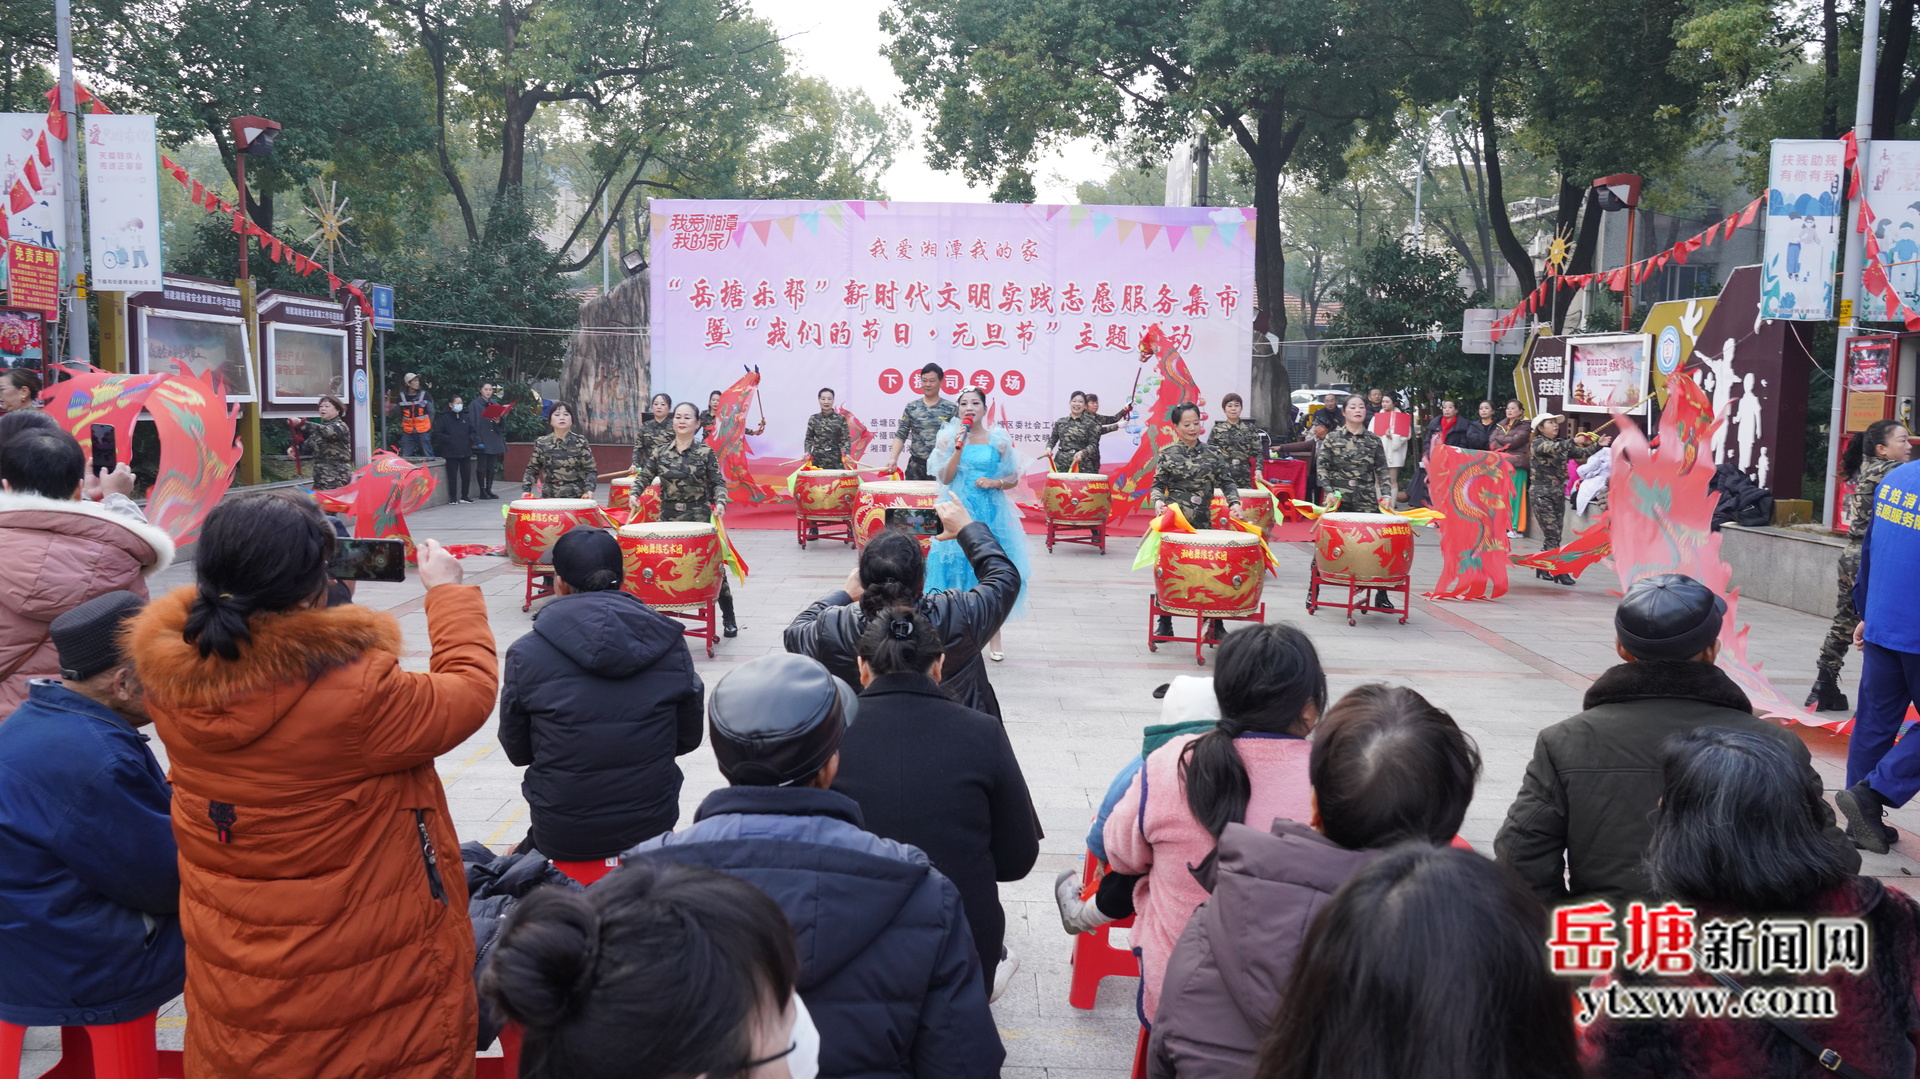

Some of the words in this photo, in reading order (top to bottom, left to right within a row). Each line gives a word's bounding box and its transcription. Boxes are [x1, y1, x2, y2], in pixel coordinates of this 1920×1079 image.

[1781, 154, 1838, 167] 扶残助残
[1780, 170, 1837, 182] 有你有我
[669, 214, 739, 233] 我爱湘潭
[672, 232, 725, 251] 我的家
[869, 237, 1039, 262] 我爱湘潭我的家
[14, 245, 55, 266] 免责声明
[668, 278, 1239, 317] “岳塘乐帮”新时代文明实践志愿服务集市
[705, 317, 1193, 352] 暨“我们的节日·元旦节”主题动
[1533, 356, 1562, 374] 安全意识
[1878, 484, 1920, 511] 蓝焰消
